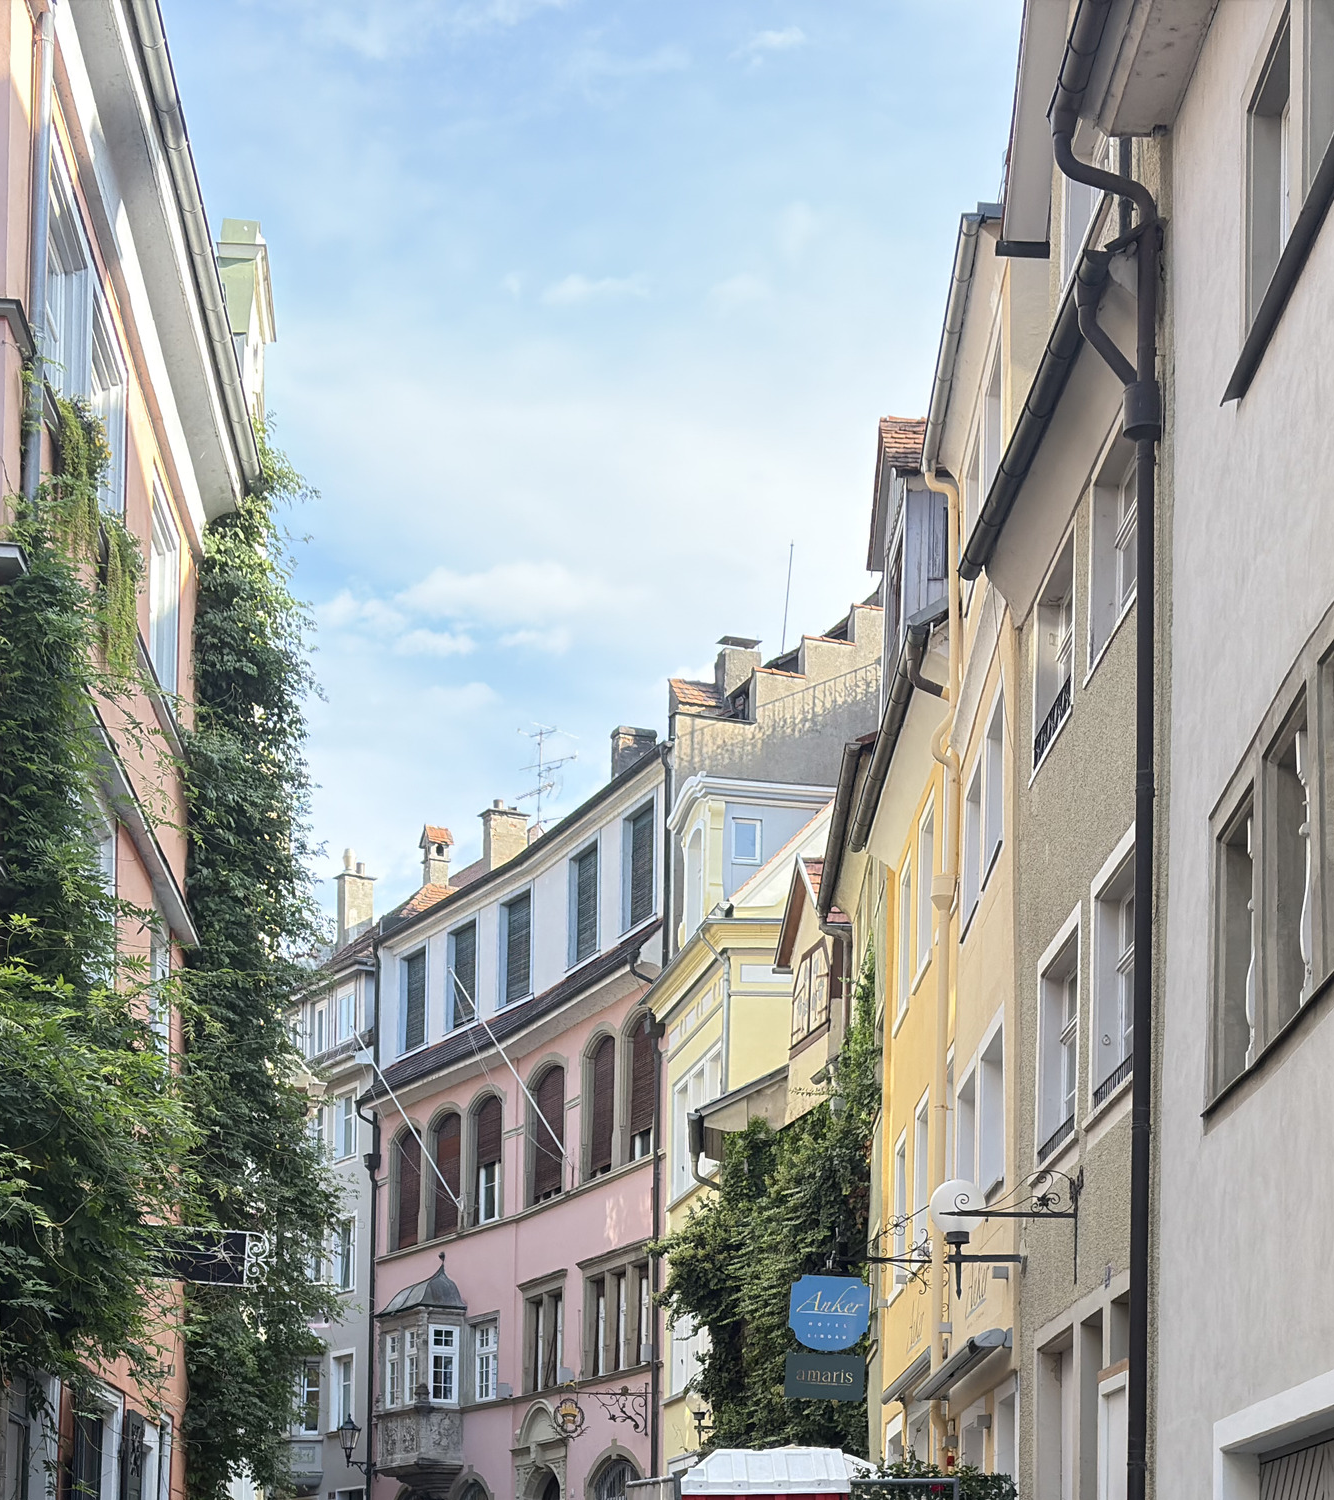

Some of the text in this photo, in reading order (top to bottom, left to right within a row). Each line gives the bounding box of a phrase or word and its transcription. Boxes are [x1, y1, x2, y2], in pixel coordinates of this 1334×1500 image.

[795, 1285, 864, 1313] Anker
[808, 1321, 847, 1329] HOTEL
[796, 1369, 854, 1384] amaris
